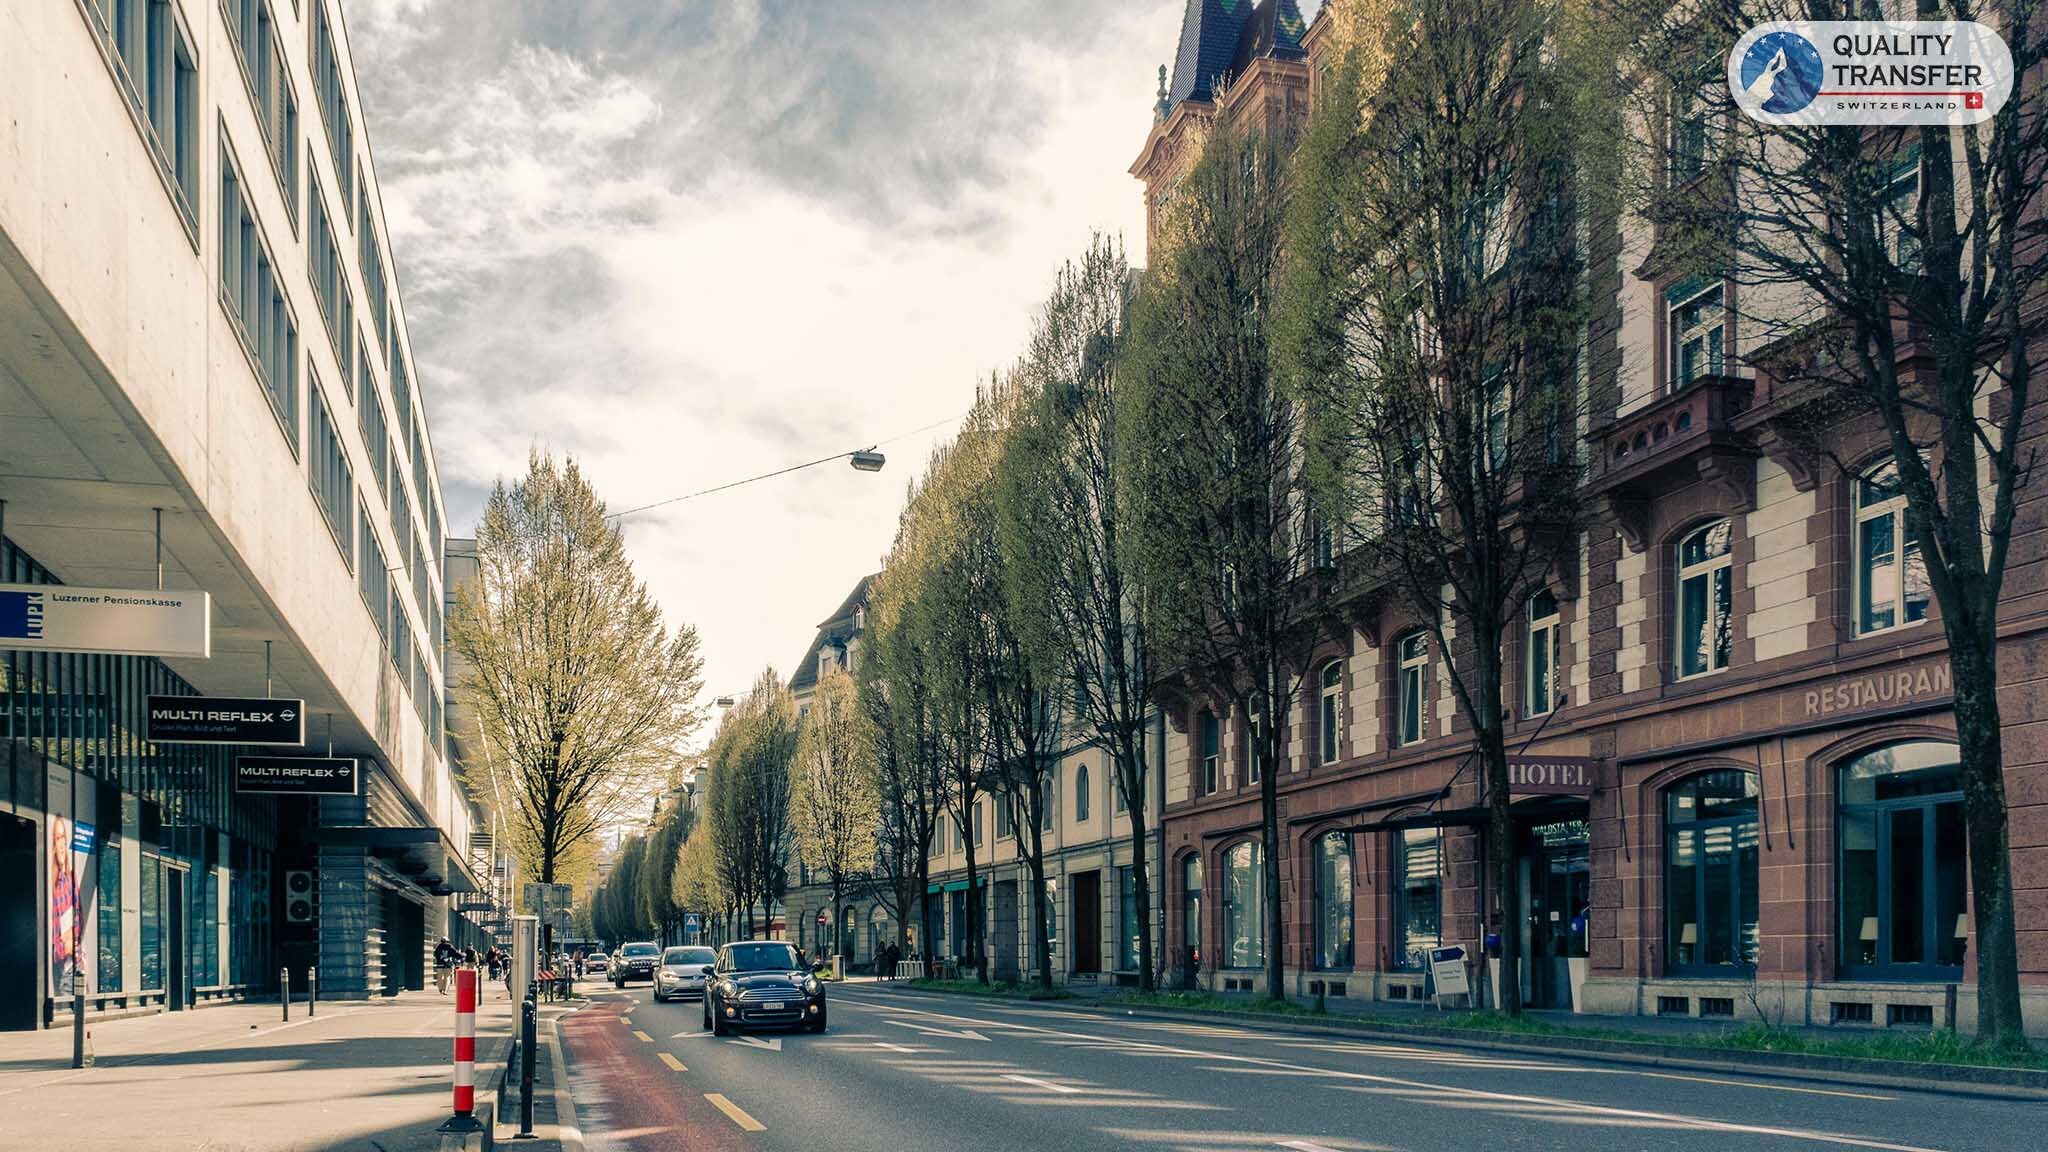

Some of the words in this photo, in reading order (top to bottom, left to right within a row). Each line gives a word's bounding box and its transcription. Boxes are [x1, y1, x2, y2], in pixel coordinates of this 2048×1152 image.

[52, 593, 100, 604] Luzerner
[104, 595, 182, 607] Pensionskasse
[27, 592, 43, 639] LUPK
[1805, 663, 1951, 715] RESTAURAN
[152, 709, 203, 720] MULTI
[207, 711, 274, 723] REFLEX
[240, 767, 280, 776] MULTI
[282, 768, 334, 777] REFLEX
[1509, 764, 1591, 785] HOTEL
